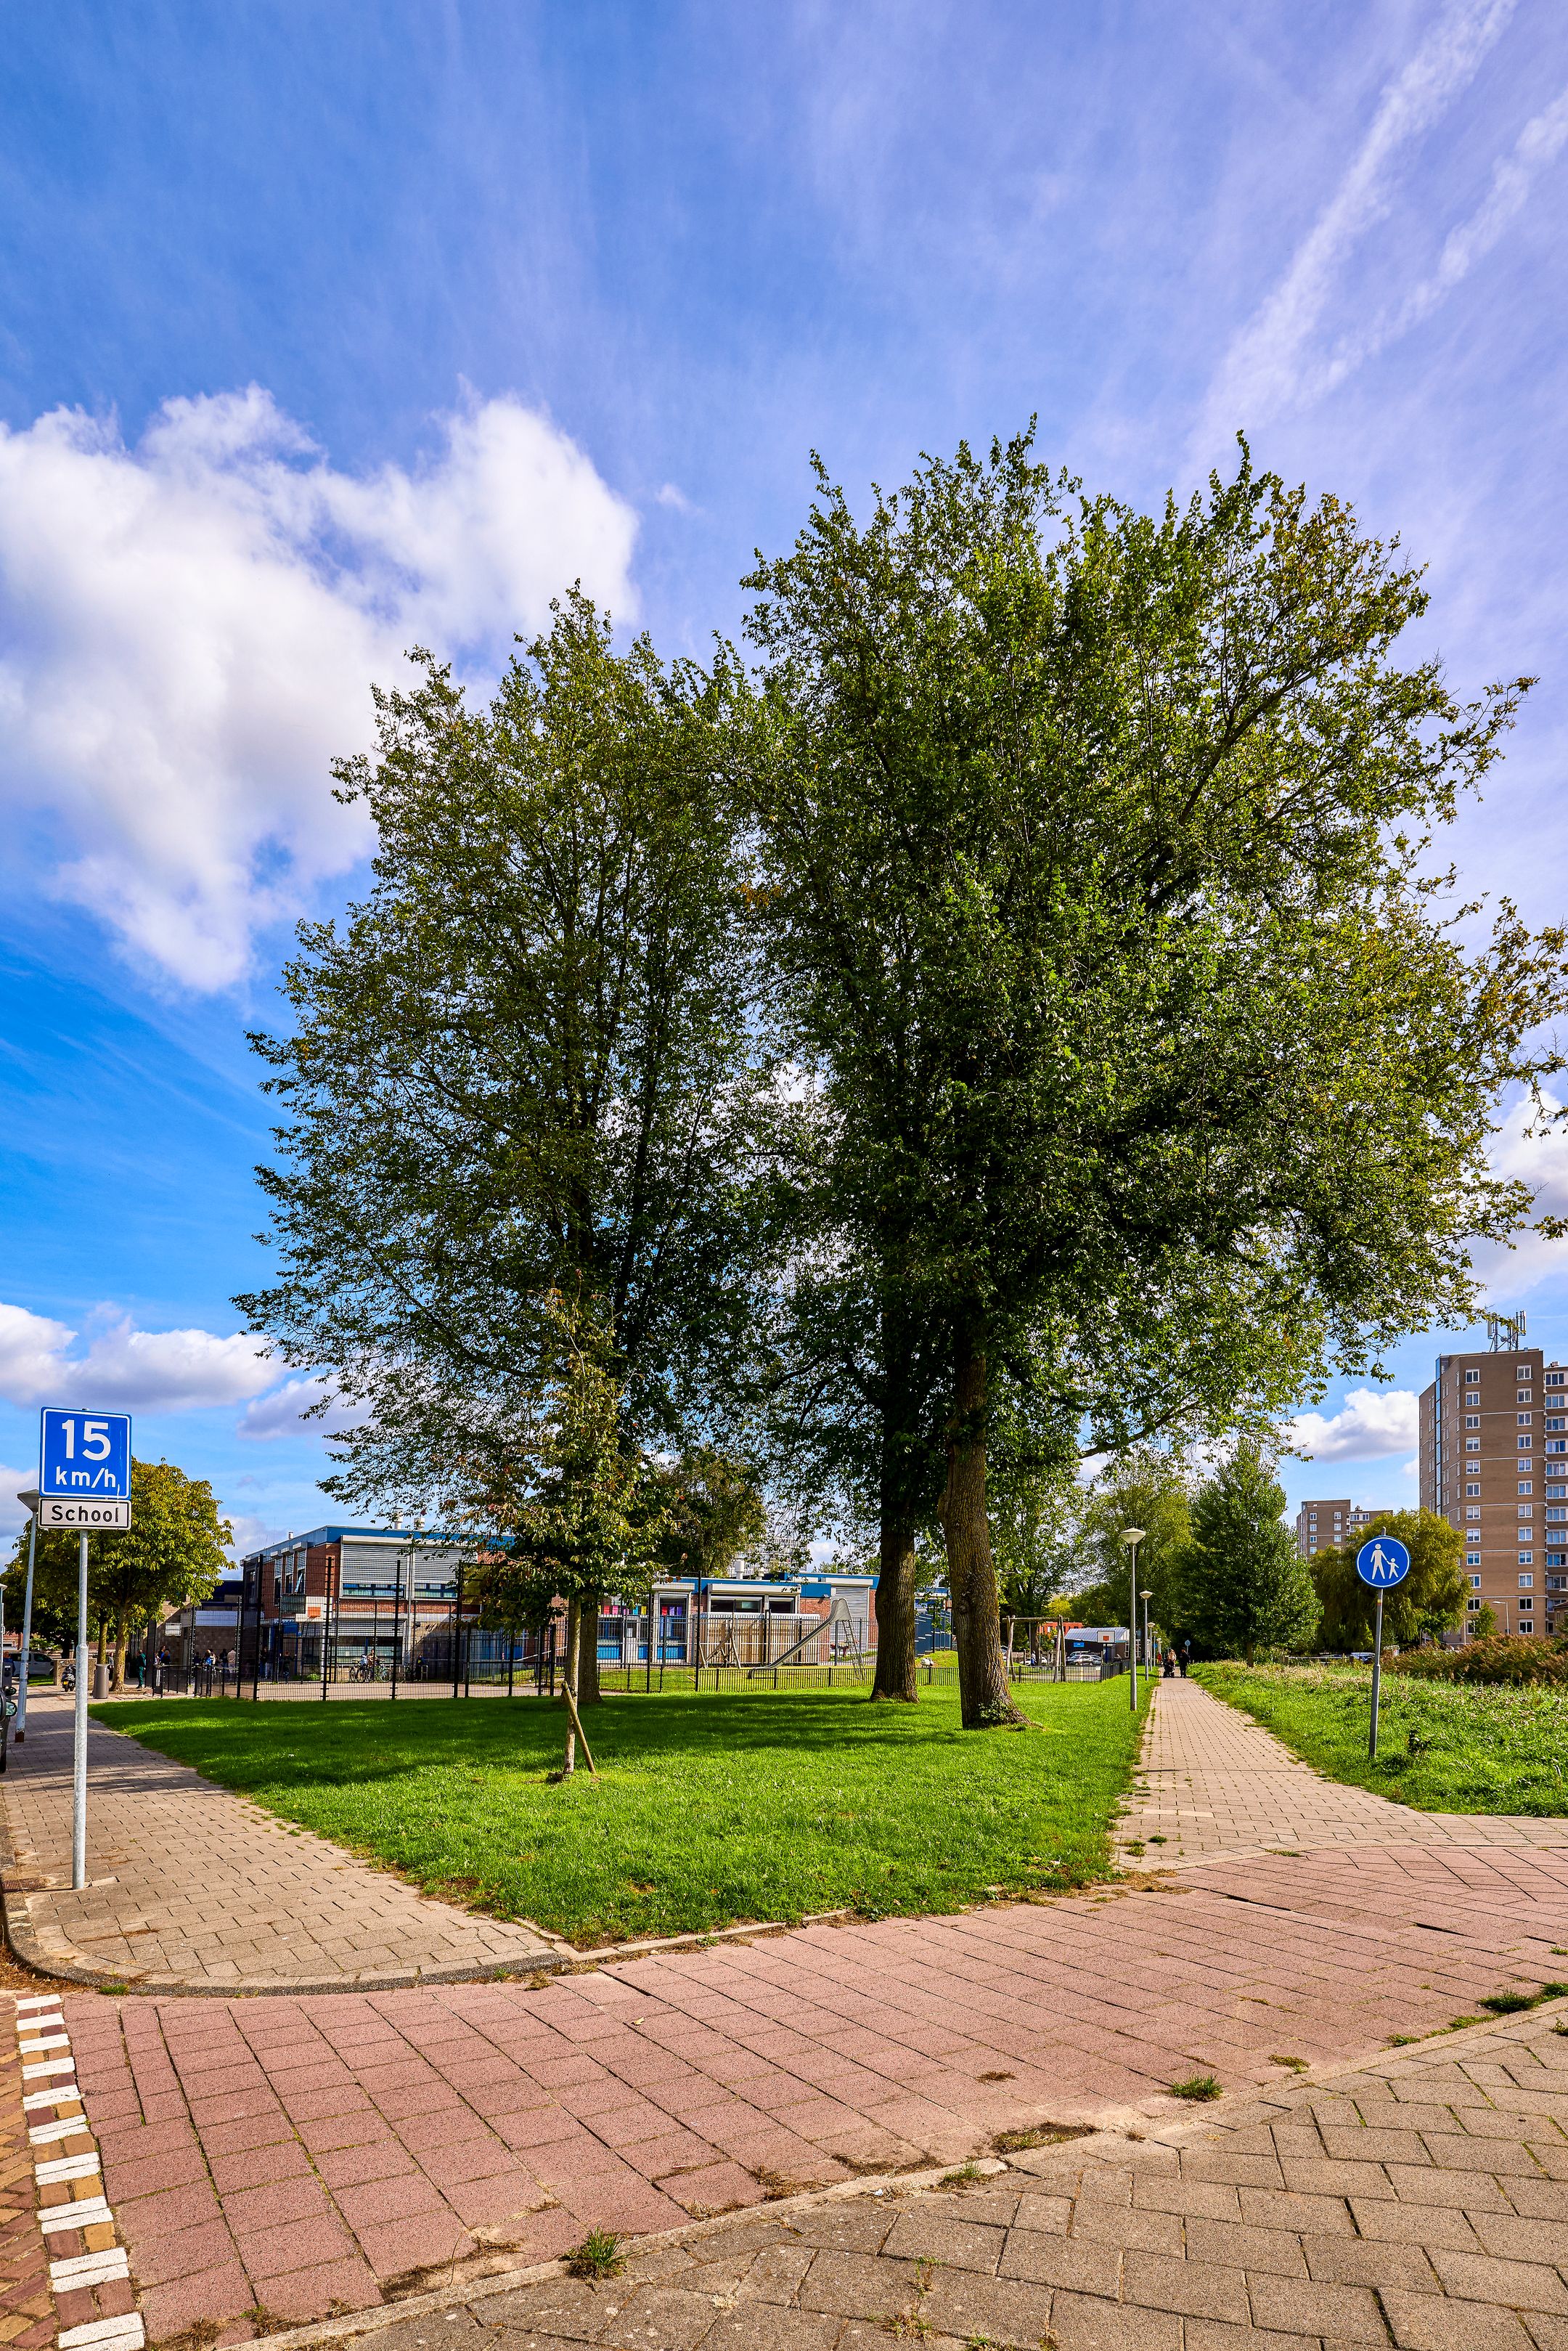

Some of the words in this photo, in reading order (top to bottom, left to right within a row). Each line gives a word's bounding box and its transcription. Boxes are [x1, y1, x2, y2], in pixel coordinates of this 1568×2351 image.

[62, 1419, 111, 1461] 15
[55, 1465, 116, 1488] km/h
[51, 1504, 119, 1523] School
